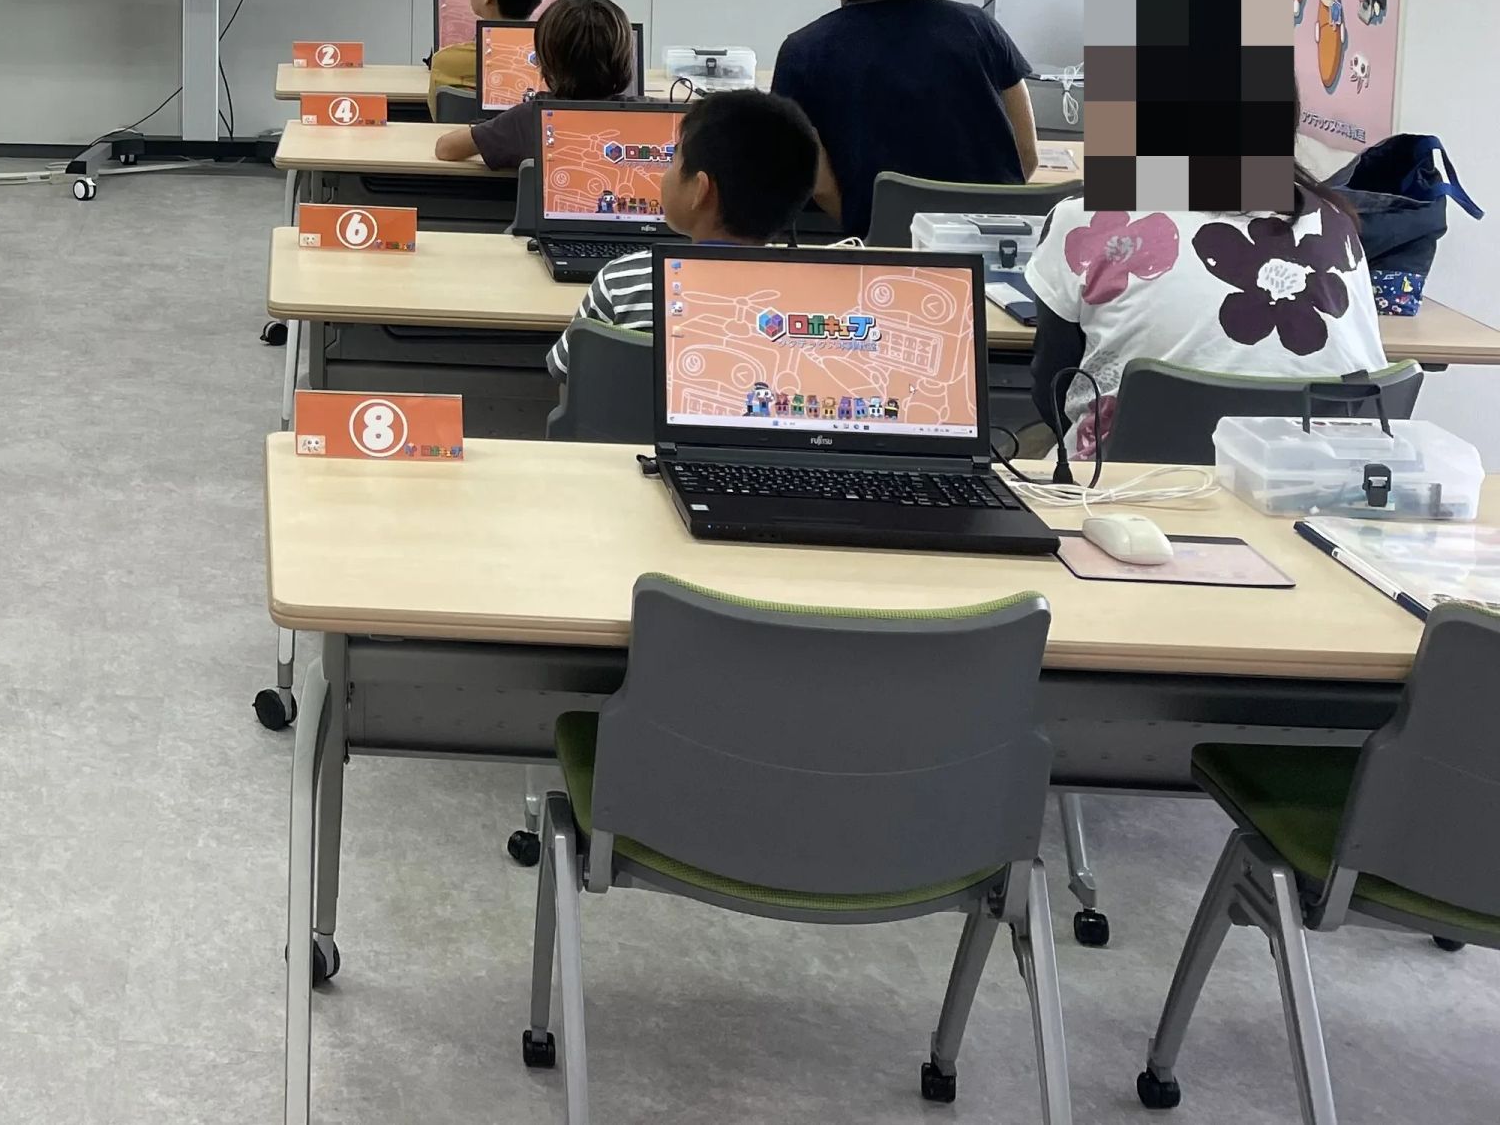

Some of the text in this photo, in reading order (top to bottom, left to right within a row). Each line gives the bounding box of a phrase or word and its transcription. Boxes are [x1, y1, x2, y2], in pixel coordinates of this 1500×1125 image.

[788, 313, 876, 339] ロボキューブ
